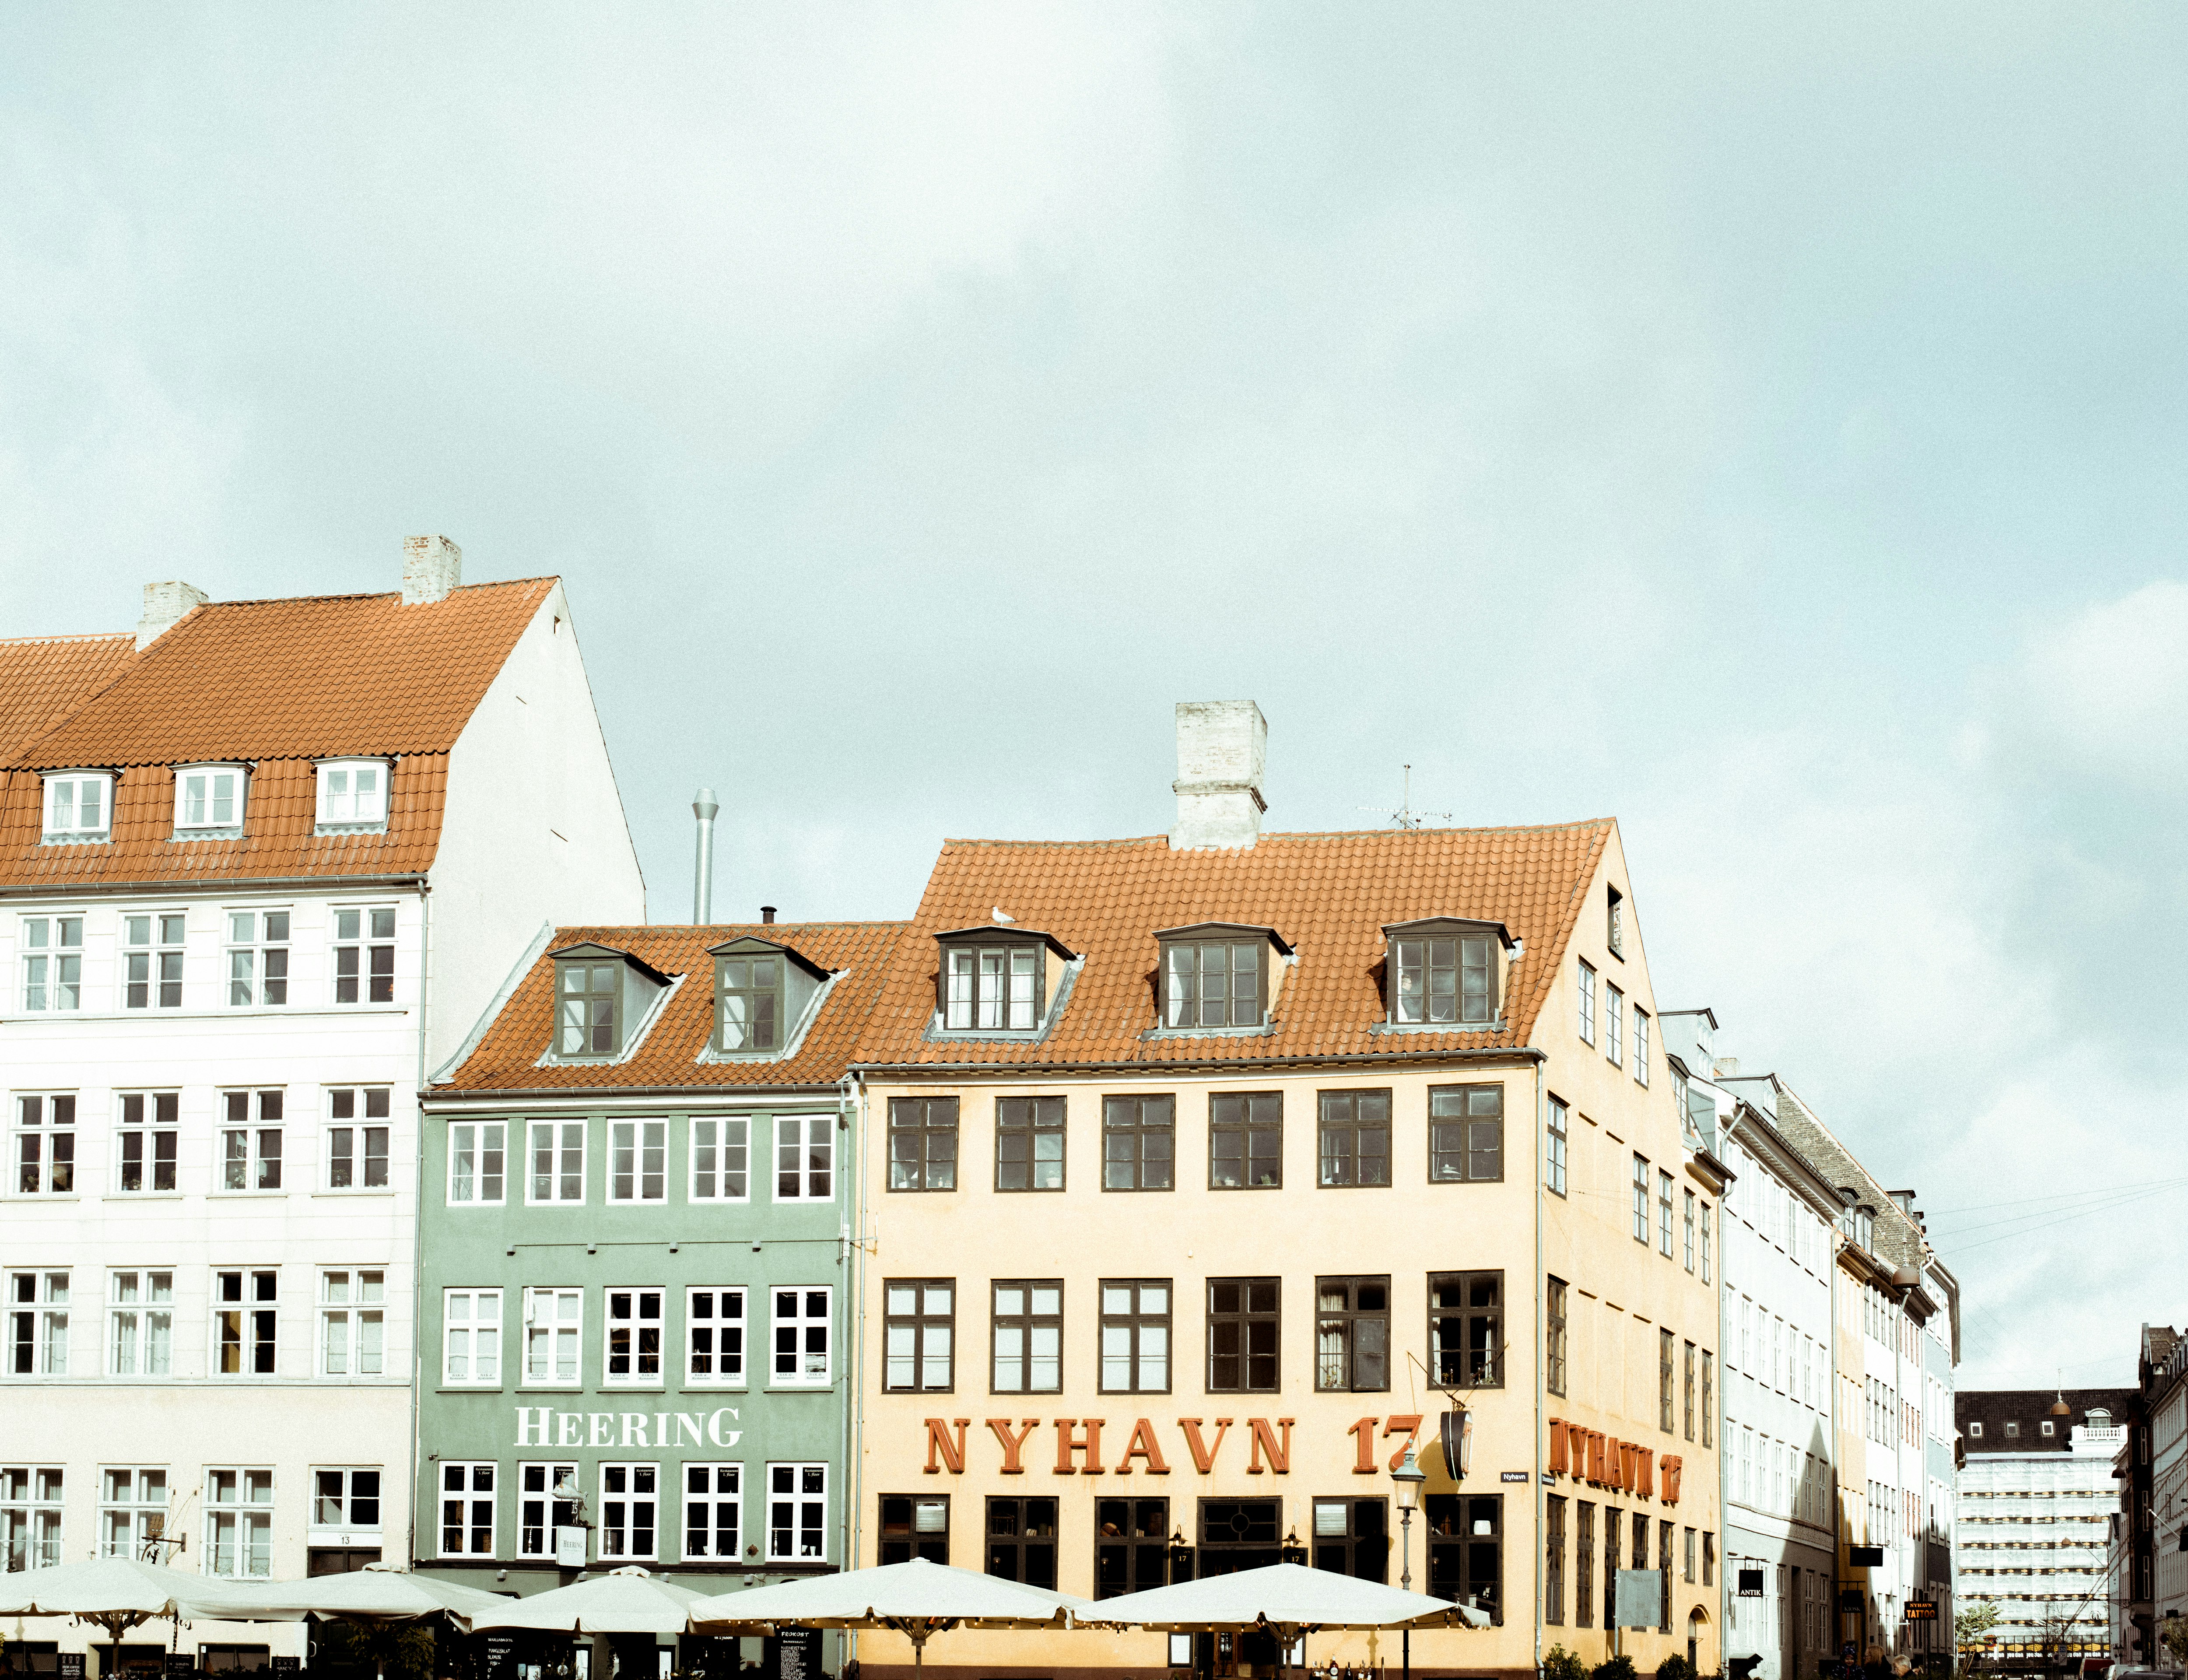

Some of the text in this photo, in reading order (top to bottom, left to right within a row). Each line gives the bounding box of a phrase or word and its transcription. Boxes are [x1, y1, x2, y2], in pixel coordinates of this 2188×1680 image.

[514, 1407, 743, 1447] HEERING
[923, 1414, 1424, 1474] NYHAVN 17
[1548, 1417, 1654, 1497] NYHAVN
[572, 1504, 578, 1514] 15
[1906, 1610, 1935, 1618] TATTOO
